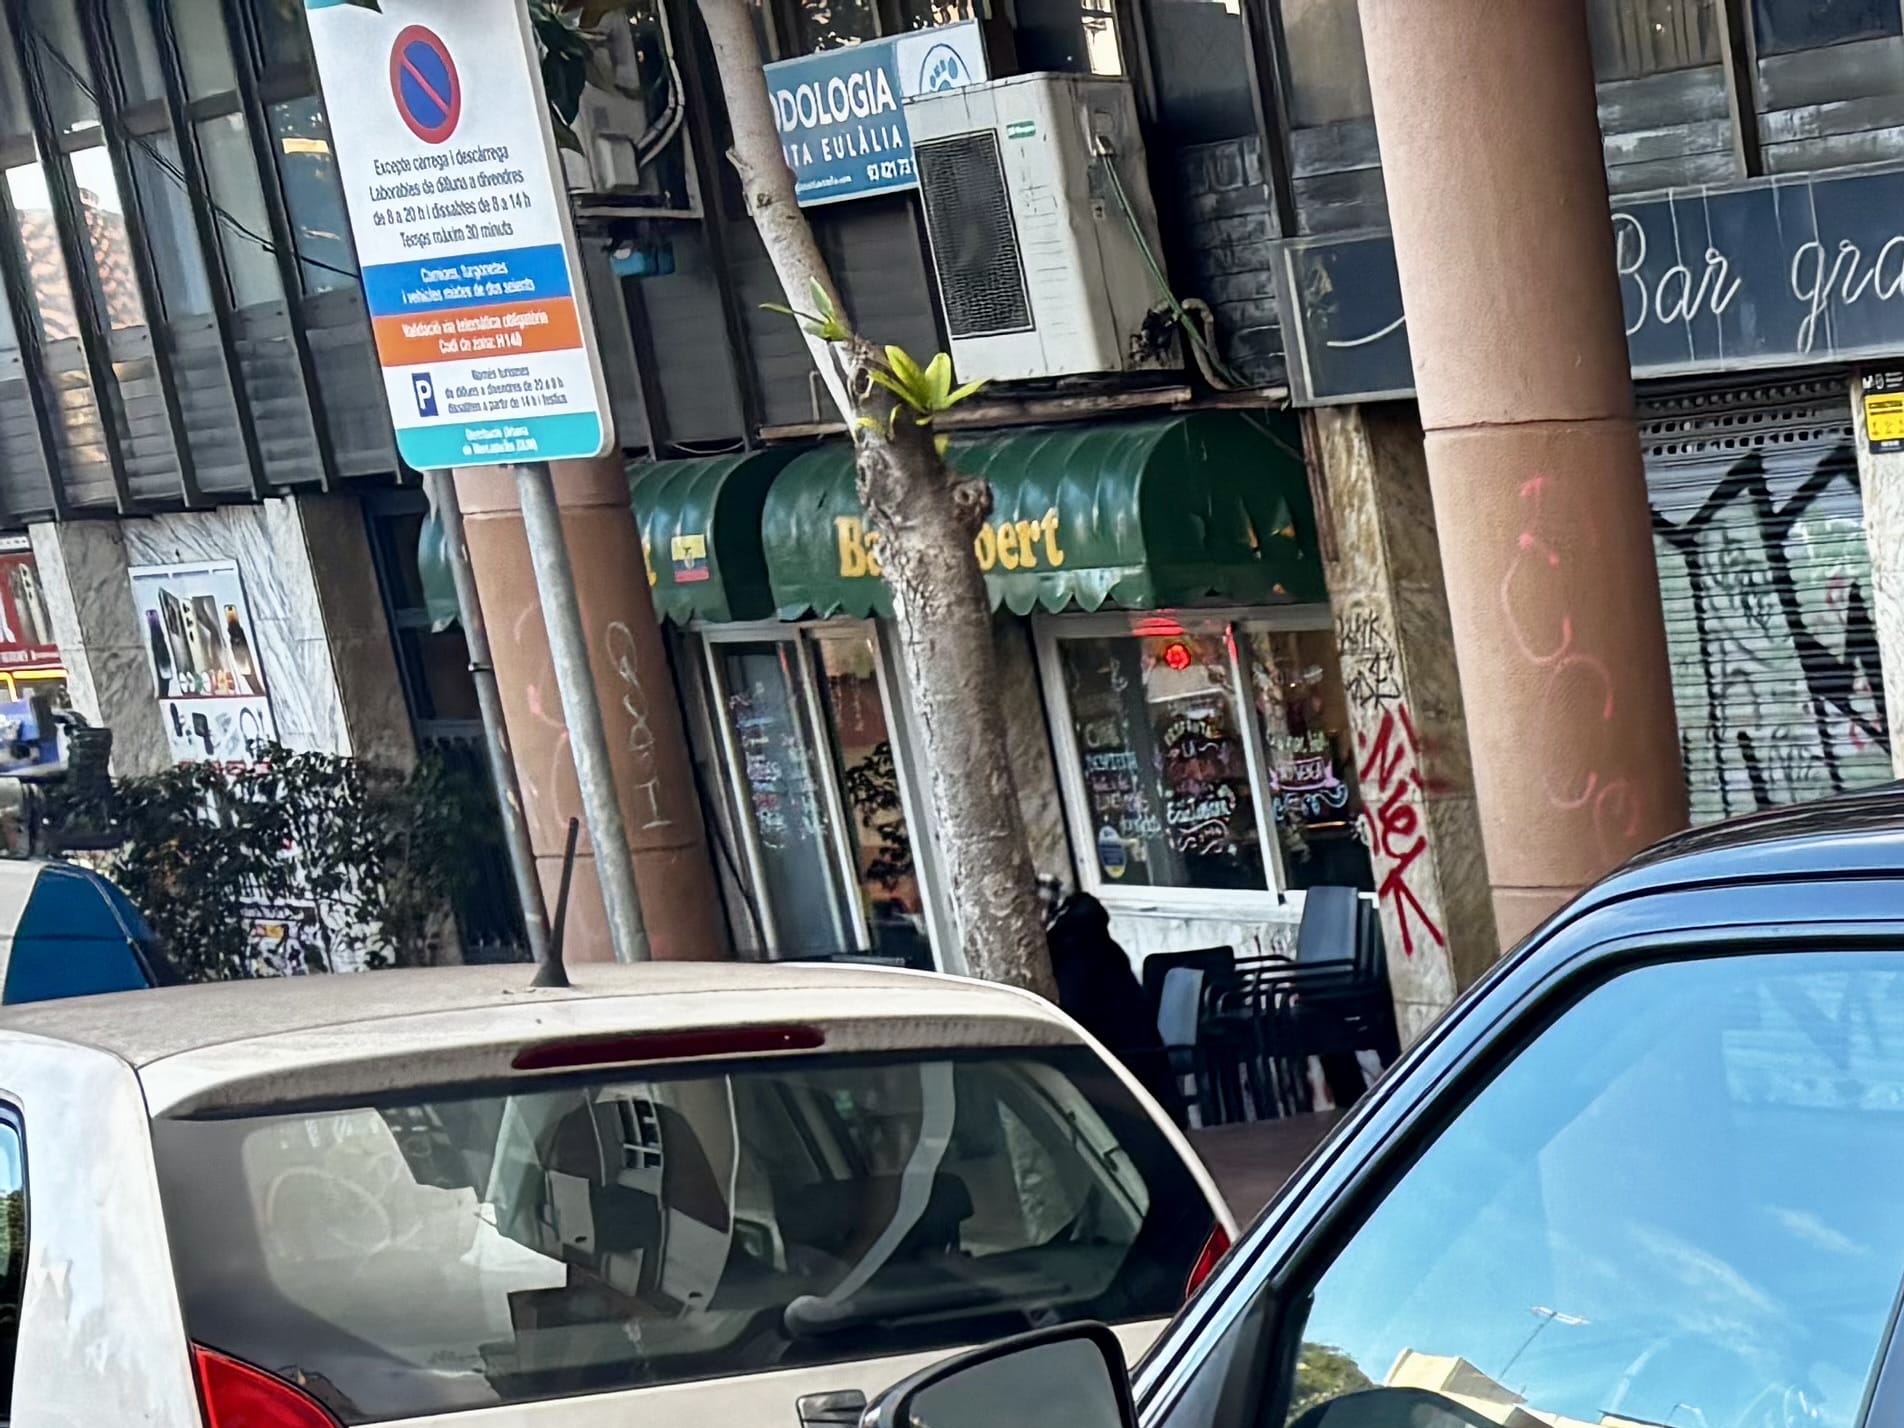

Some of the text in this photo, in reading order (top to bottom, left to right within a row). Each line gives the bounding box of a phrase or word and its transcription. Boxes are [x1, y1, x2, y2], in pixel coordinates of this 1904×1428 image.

[769, 67, 897, 132] DOLOGIA
[822, 124, 903, 162] EULÀLIA
[422, 178, 435, 194] de
[373, 211, 386, 226] de
[387, 208, 395, 224] 8
[396, 210, 403, 223] a
[404, 205, 417, 223] 20
[417, 205, 424, 220] h
[478, 196, 491, 213] de
[492, 195, 500, 211] 8
[500, 197, 508, 211] a
[509, 192, 523, 209] 14
[523, 191, 532, 208] h
[465, 223, 479, 240] 30
[1611, 213, 1741, 336] Bar
[415, 380, 432, 410] P
[836, 514, 885, 577] Ba
